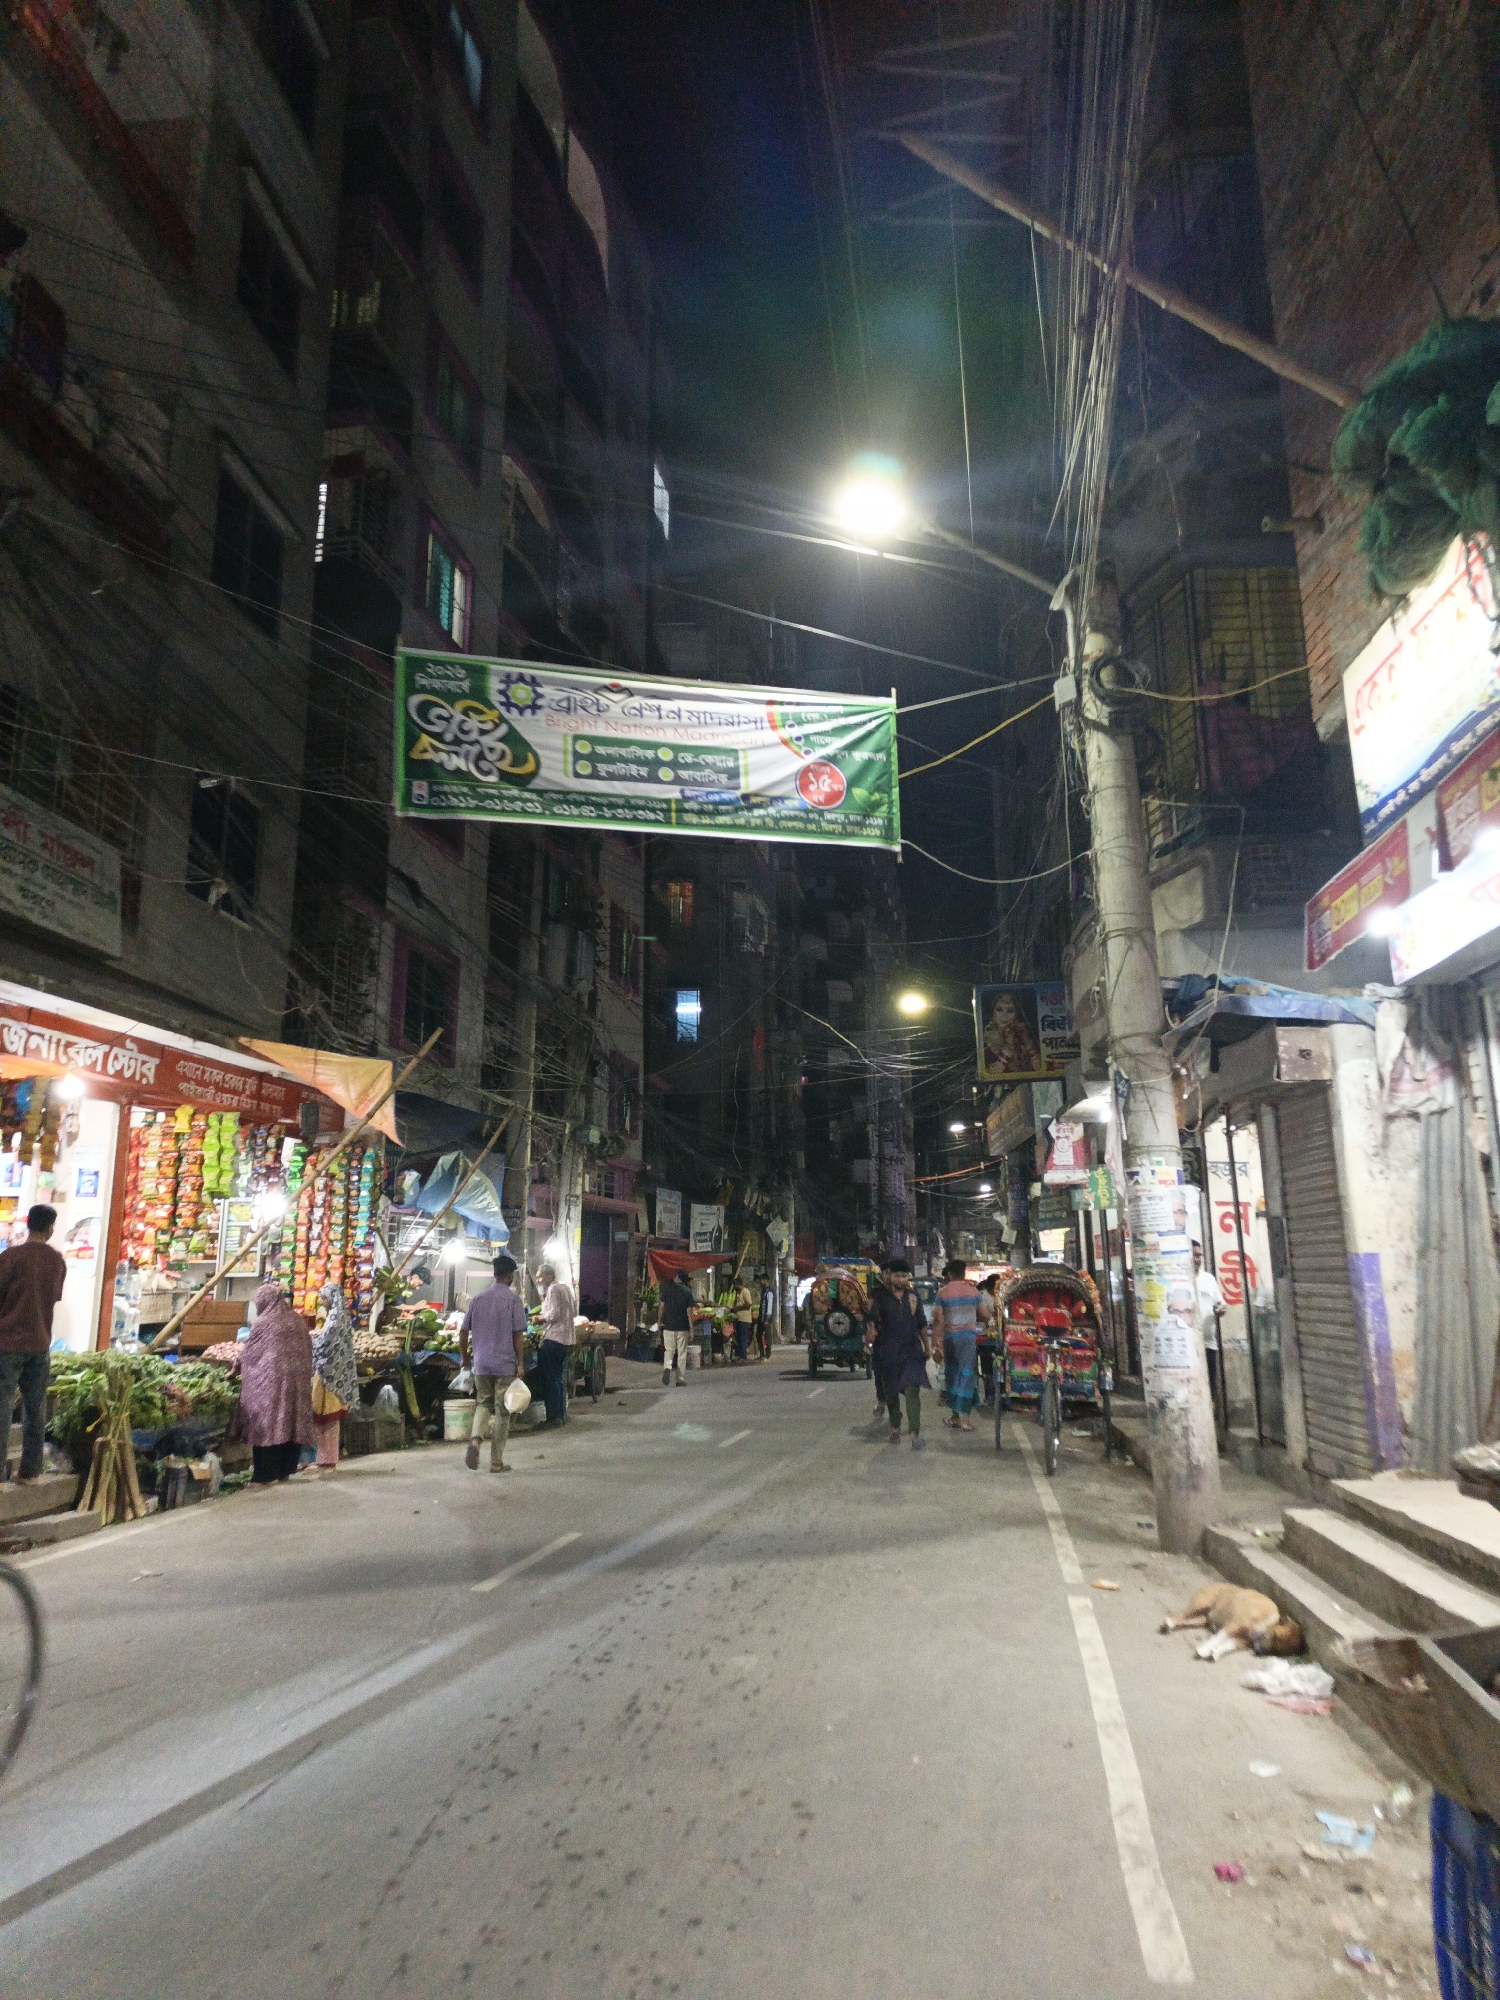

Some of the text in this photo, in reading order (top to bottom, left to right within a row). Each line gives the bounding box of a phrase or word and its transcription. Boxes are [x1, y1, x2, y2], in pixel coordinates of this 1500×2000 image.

[545, 714, 598, 733] Bright
[605, 720, 667, 738] Nation
[808, 771, 832, 792] ১৫
[107, 1038, 160, 1085] স্টোর
